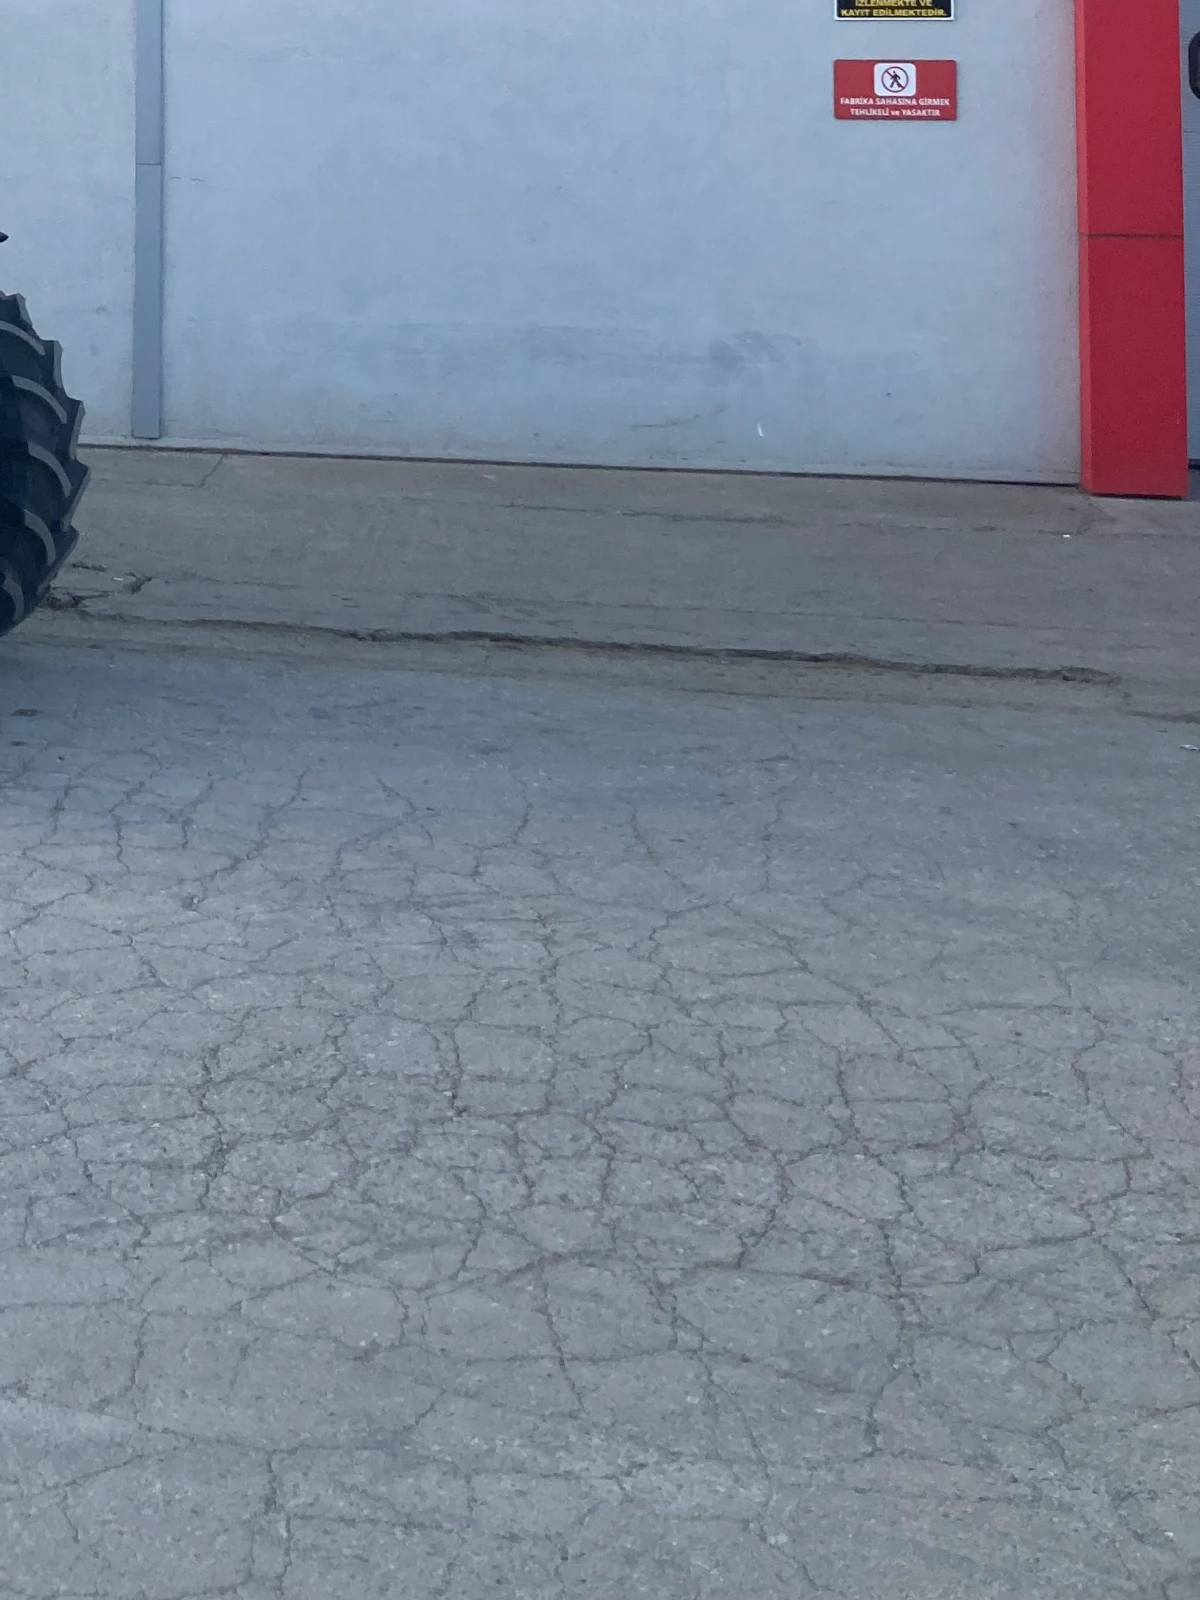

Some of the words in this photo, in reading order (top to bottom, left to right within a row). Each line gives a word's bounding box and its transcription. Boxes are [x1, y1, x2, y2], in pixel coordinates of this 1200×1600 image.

[919, 0, 933, 7] VE
[841, 8, 870, 17] KAYIT
[840, 96, 874, 105] FABRİKA
[876, 97, 917, 106] SAHASINA
[919, 97, 950, 106] GİRMEK
[850, 107, 890, 116] TEHLİKELİ
[902, 108, 941, 117] YASAKTIR
